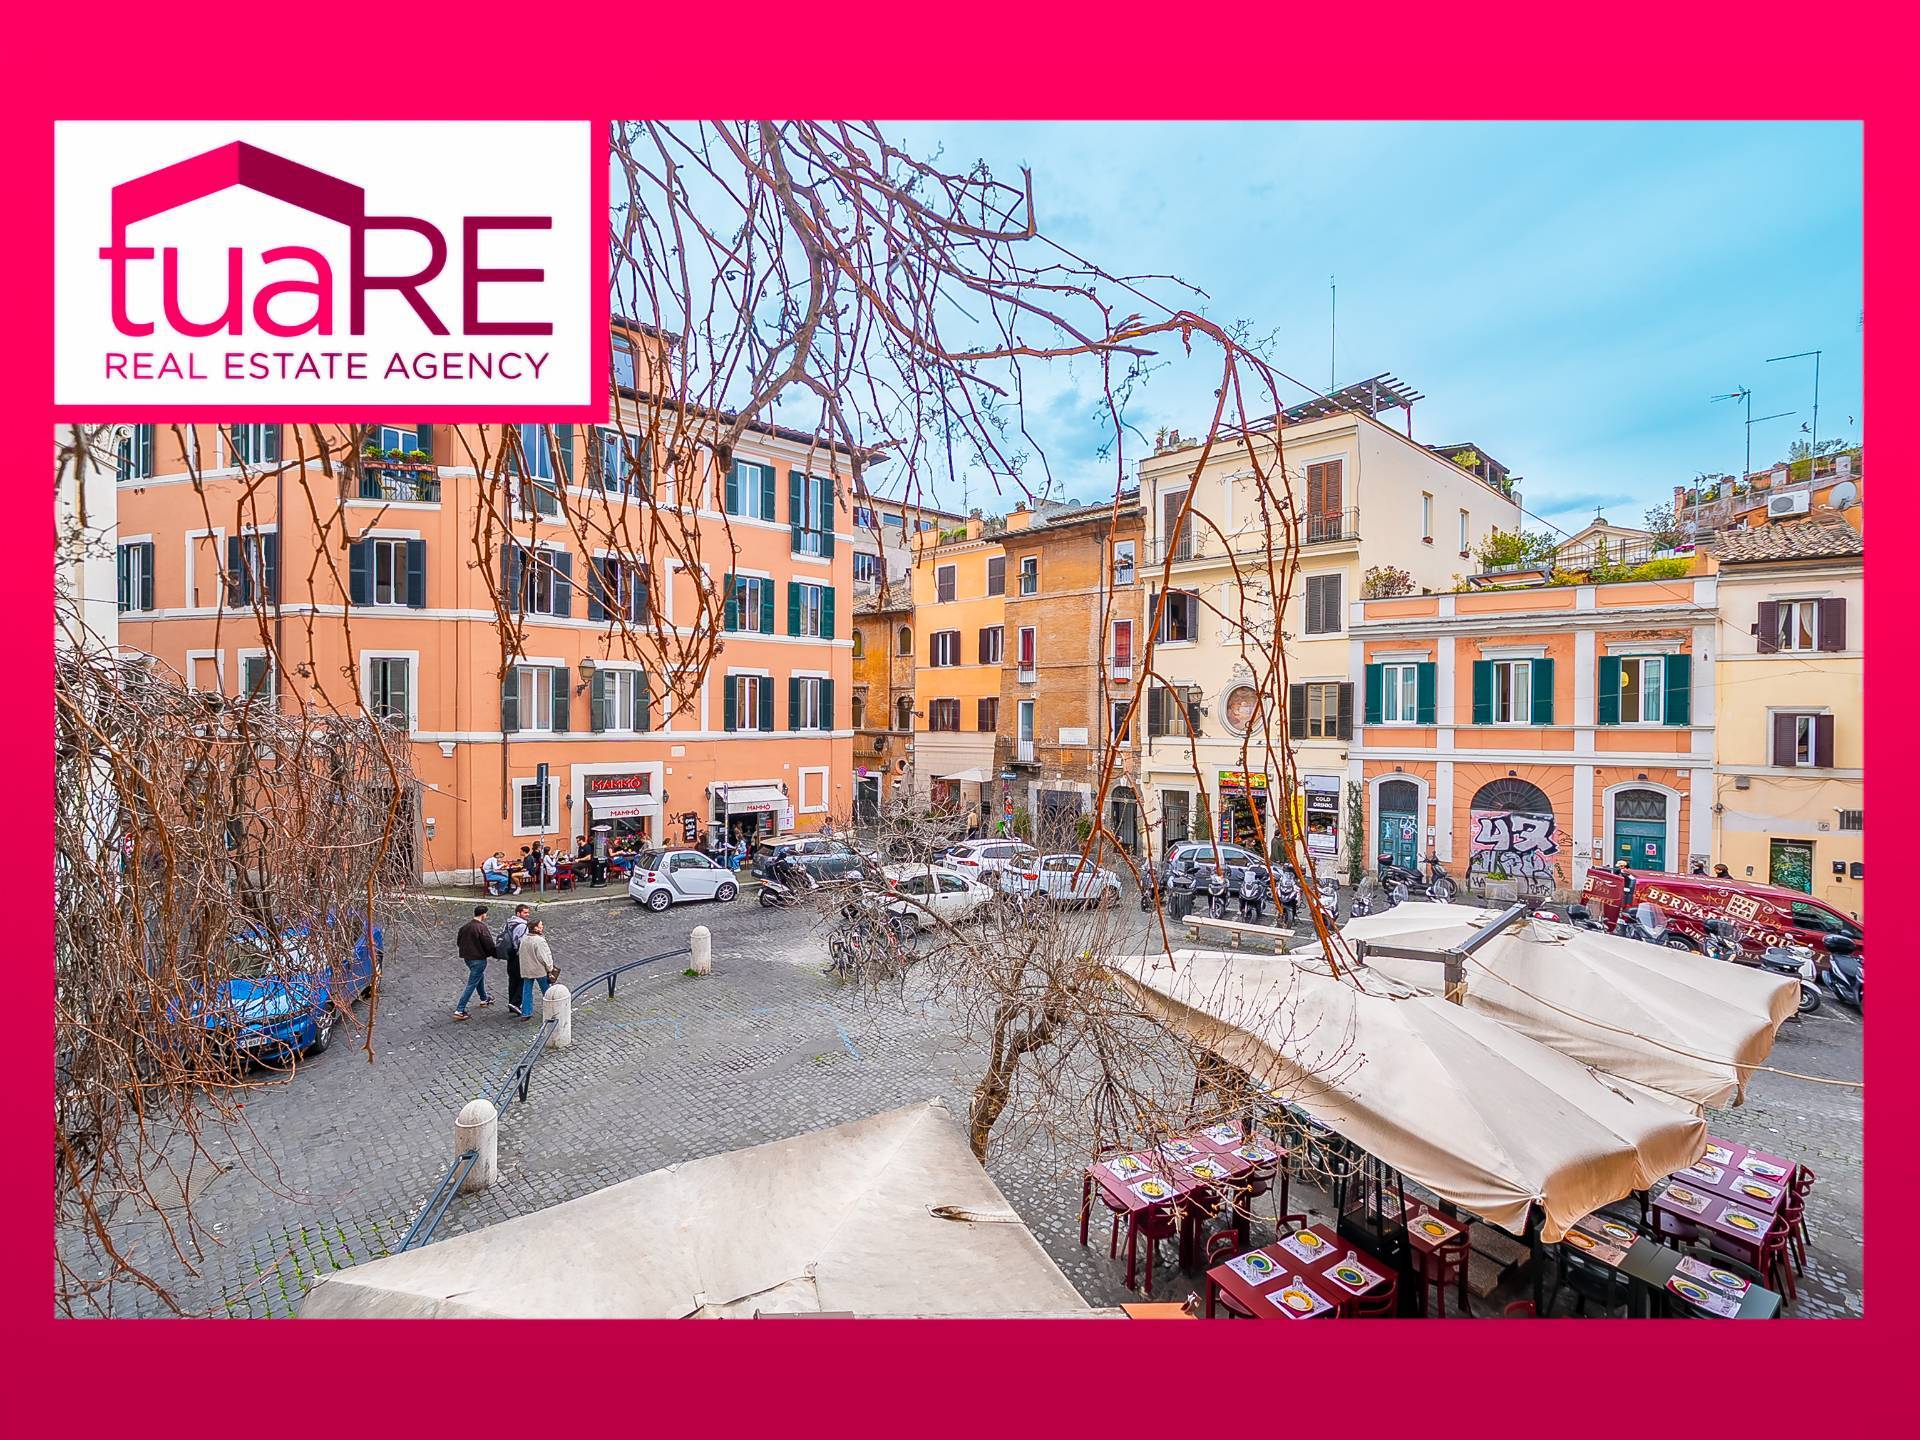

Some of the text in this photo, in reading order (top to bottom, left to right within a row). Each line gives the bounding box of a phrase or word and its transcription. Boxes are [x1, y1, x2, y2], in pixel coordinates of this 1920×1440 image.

[591, 775, 644, 791] MAMMÒ
[746, 802, 771, 811] MAMMÒ
[610, 808, 640, 817] MAMMÒ
